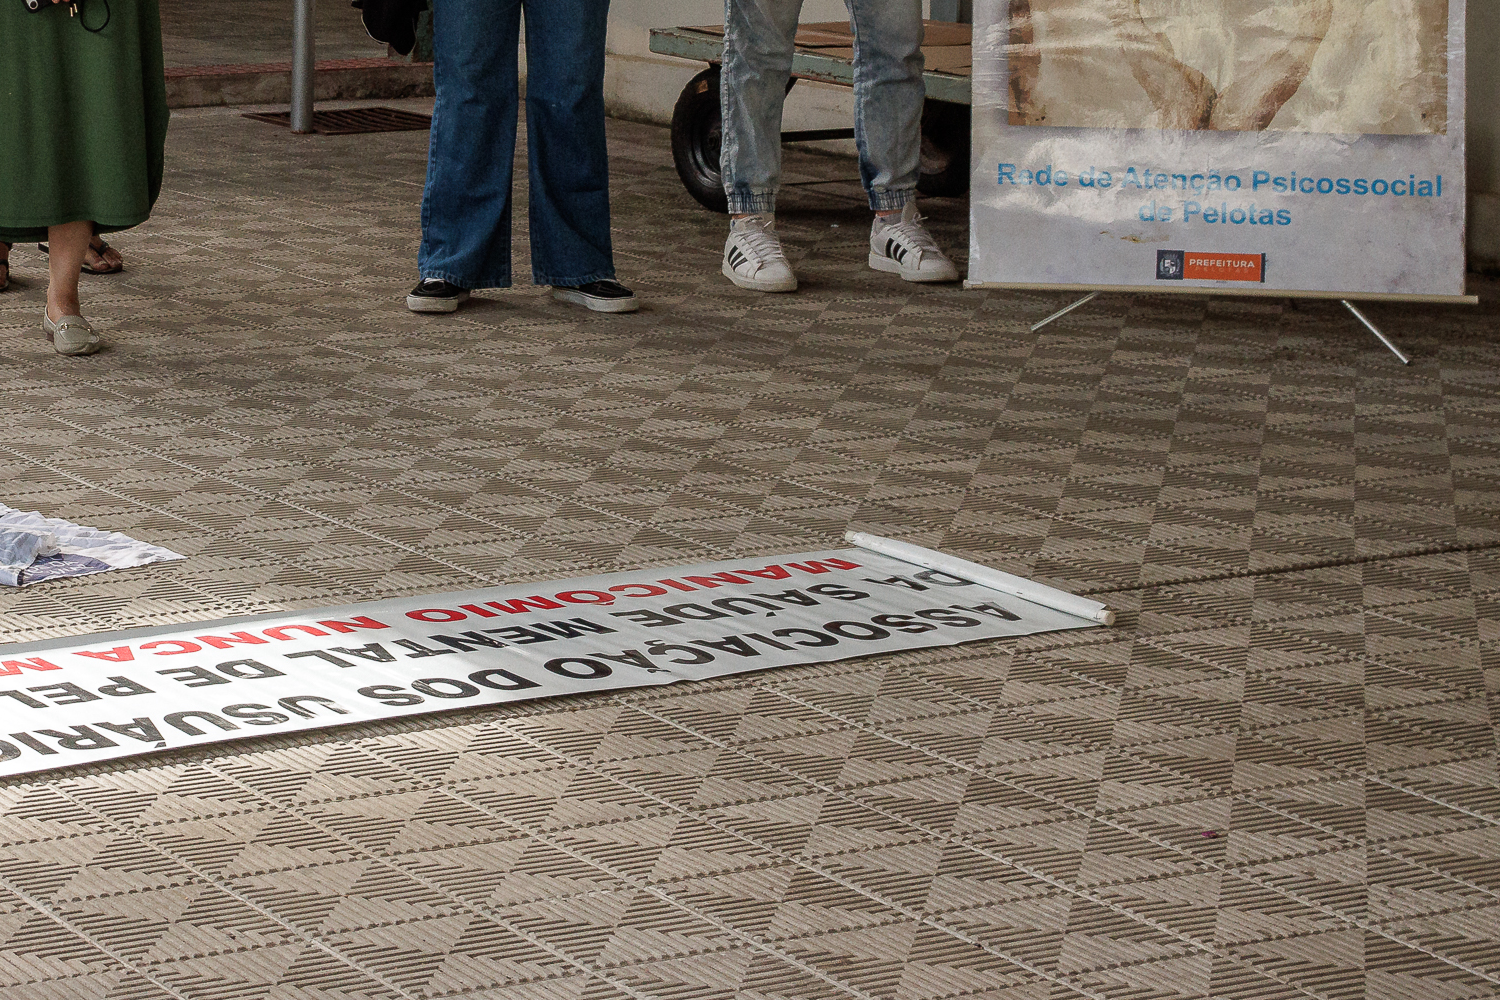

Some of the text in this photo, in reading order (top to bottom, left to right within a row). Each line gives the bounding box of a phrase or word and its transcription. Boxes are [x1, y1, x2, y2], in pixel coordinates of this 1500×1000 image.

[997, 163, 1442, 198] Rede de Atenção Psicossocial
[1138, 200, 1292, 227] de Pelotas
[1189, 258, 1255, 268] PREFEITURA
[406, 558, 864, 623] MANICÔMIO
[609, 583, 871, 628] SAÚDE
[72, 615, 390, 663] NUNCA
[284, 616, 619, 668] MENTAL
[544, 601, 1022, 680] ASSOCIAÇÃO
[159, 658, 287, 688] DE
[357, 668, 542, 707] DOS
